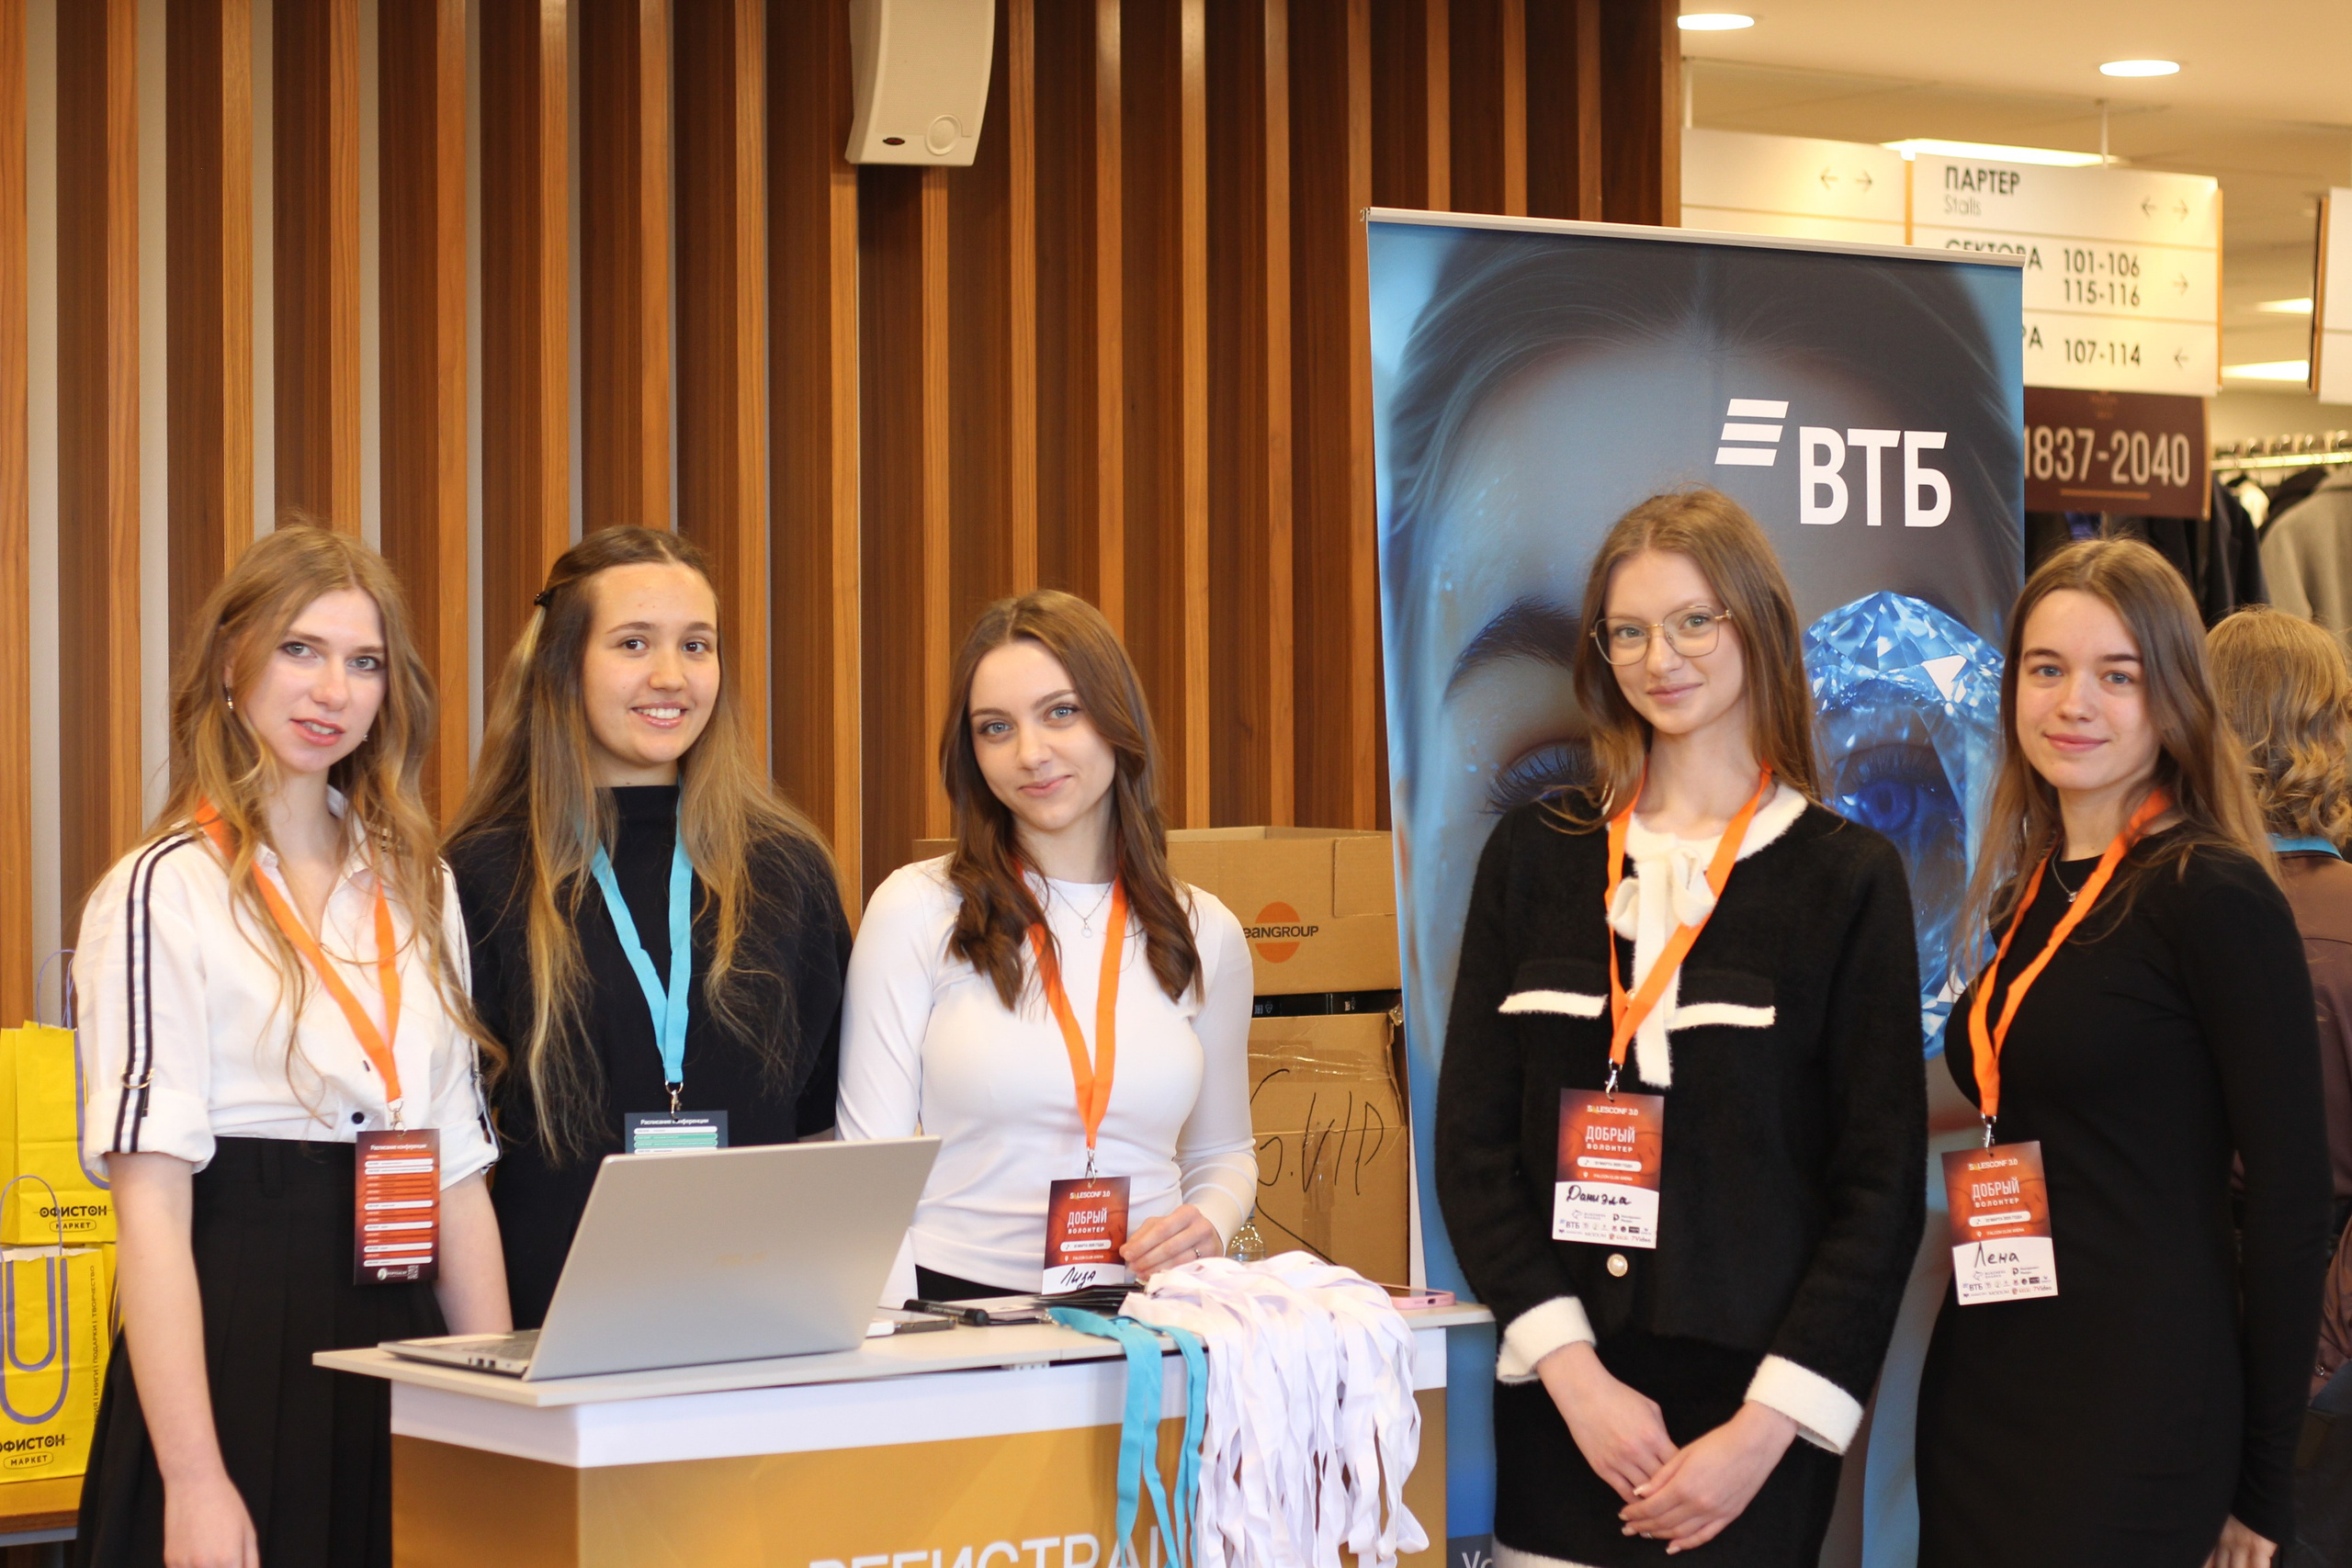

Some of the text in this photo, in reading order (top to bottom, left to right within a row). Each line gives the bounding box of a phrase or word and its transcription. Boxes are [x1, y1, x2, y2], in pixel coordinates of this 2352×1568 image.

[1945, 165, 2020, 196] ПАРТЕР
[1944, 195, 1982, 216] Stalls
[2064, 247, 2140, 276] 101-106
[2064, 278, 2140, 307] 115-116
[2065, 338, 2141, 366] 107-114
[2024, 424, 2190, 487] 1837-2040
[1799, 425, 1951, 528] ВТБ
[1628, 1107, 1639, 1116] 3.0
[1585, 1125, 1635, 1144] ДОБРЫЙ
[1586, 1143, 1634, 1153] ВОЛОНТЕР
[2008, 1158, 2018, 1167] 3.0
[1972, 1177, 2020, 1201] ДОБРЫЙ
[40, 1205, 107, 1218] ОФИСТОН
[1974, 1198, 2019, 1208] ВОЛОНТЕР
[1068, 1207, 1107, 1228] ДОБРЫЙ
[1566, 1221, 1580, 1229] ВТБ
[1068, 1226, 1105, 1235] ВОЛОНТЕР
[1974, 1241, 2019, 1269] Лена
[1969, 1283, 1983, 1292] ВТБ
[10, 1454, 48, 1467] МАРКЕТ
